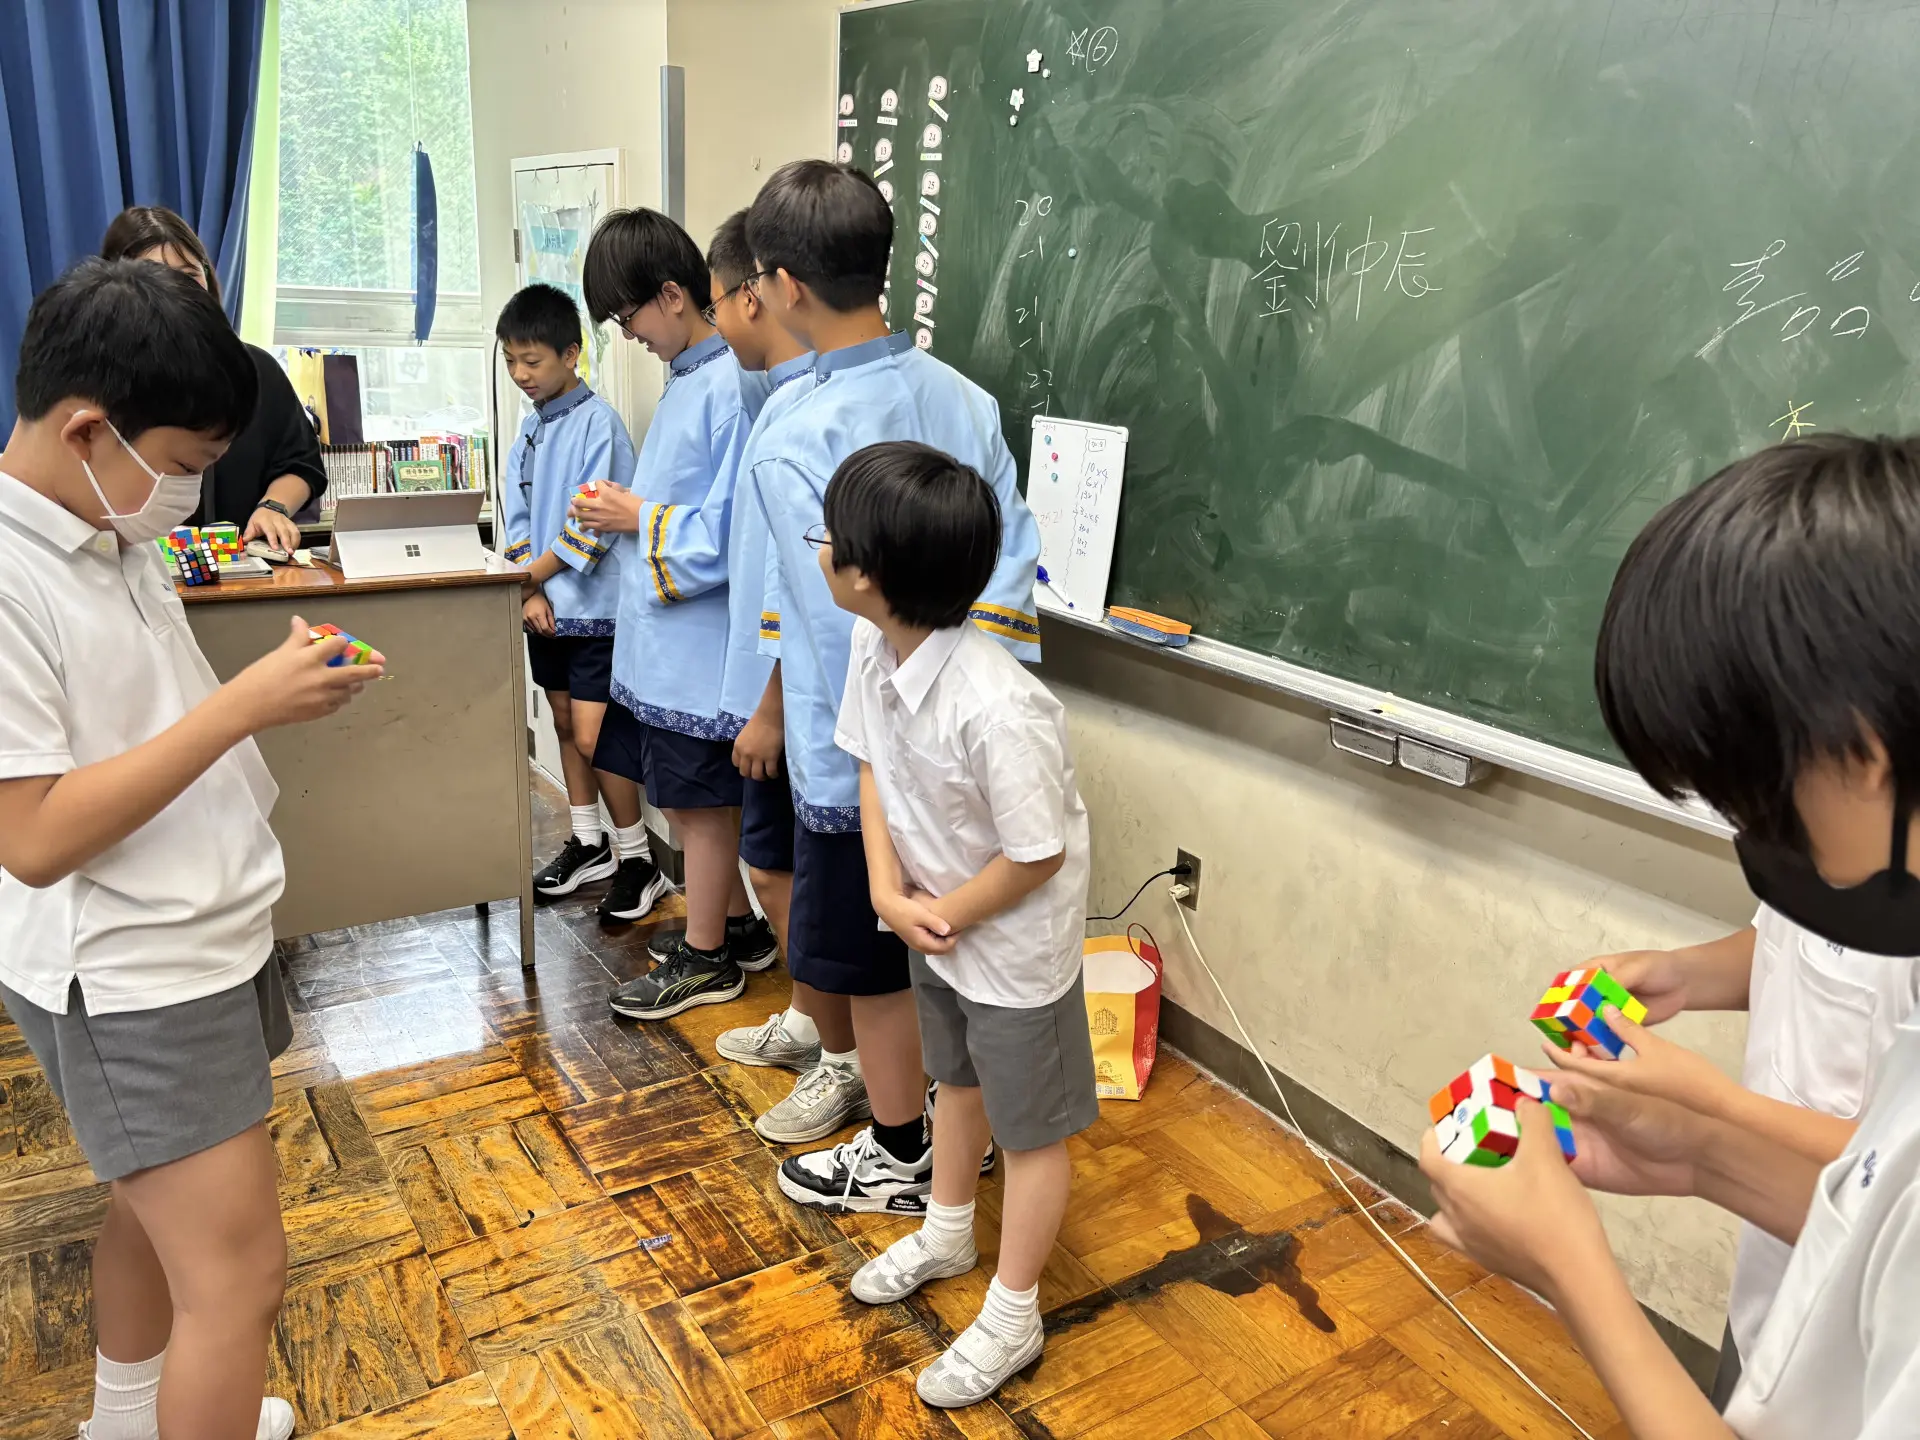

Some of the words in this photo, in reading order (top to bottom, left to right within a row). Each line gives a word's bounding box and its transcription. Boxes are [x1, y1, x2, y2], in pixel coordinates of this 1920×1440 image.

[934, 83, 942, 95] 23
[928, 132, 936, 141] 24
[927, 180, 935, 190] 25
[1015, 196, 1053, 226] 20
[924, 220, 932, 230] 26
[921, 259, 929, 270] 27
[921, 300, 928, 309] 28
[920, 335, 928, 344] 29
[1026, 369, 1053, 389] 22
